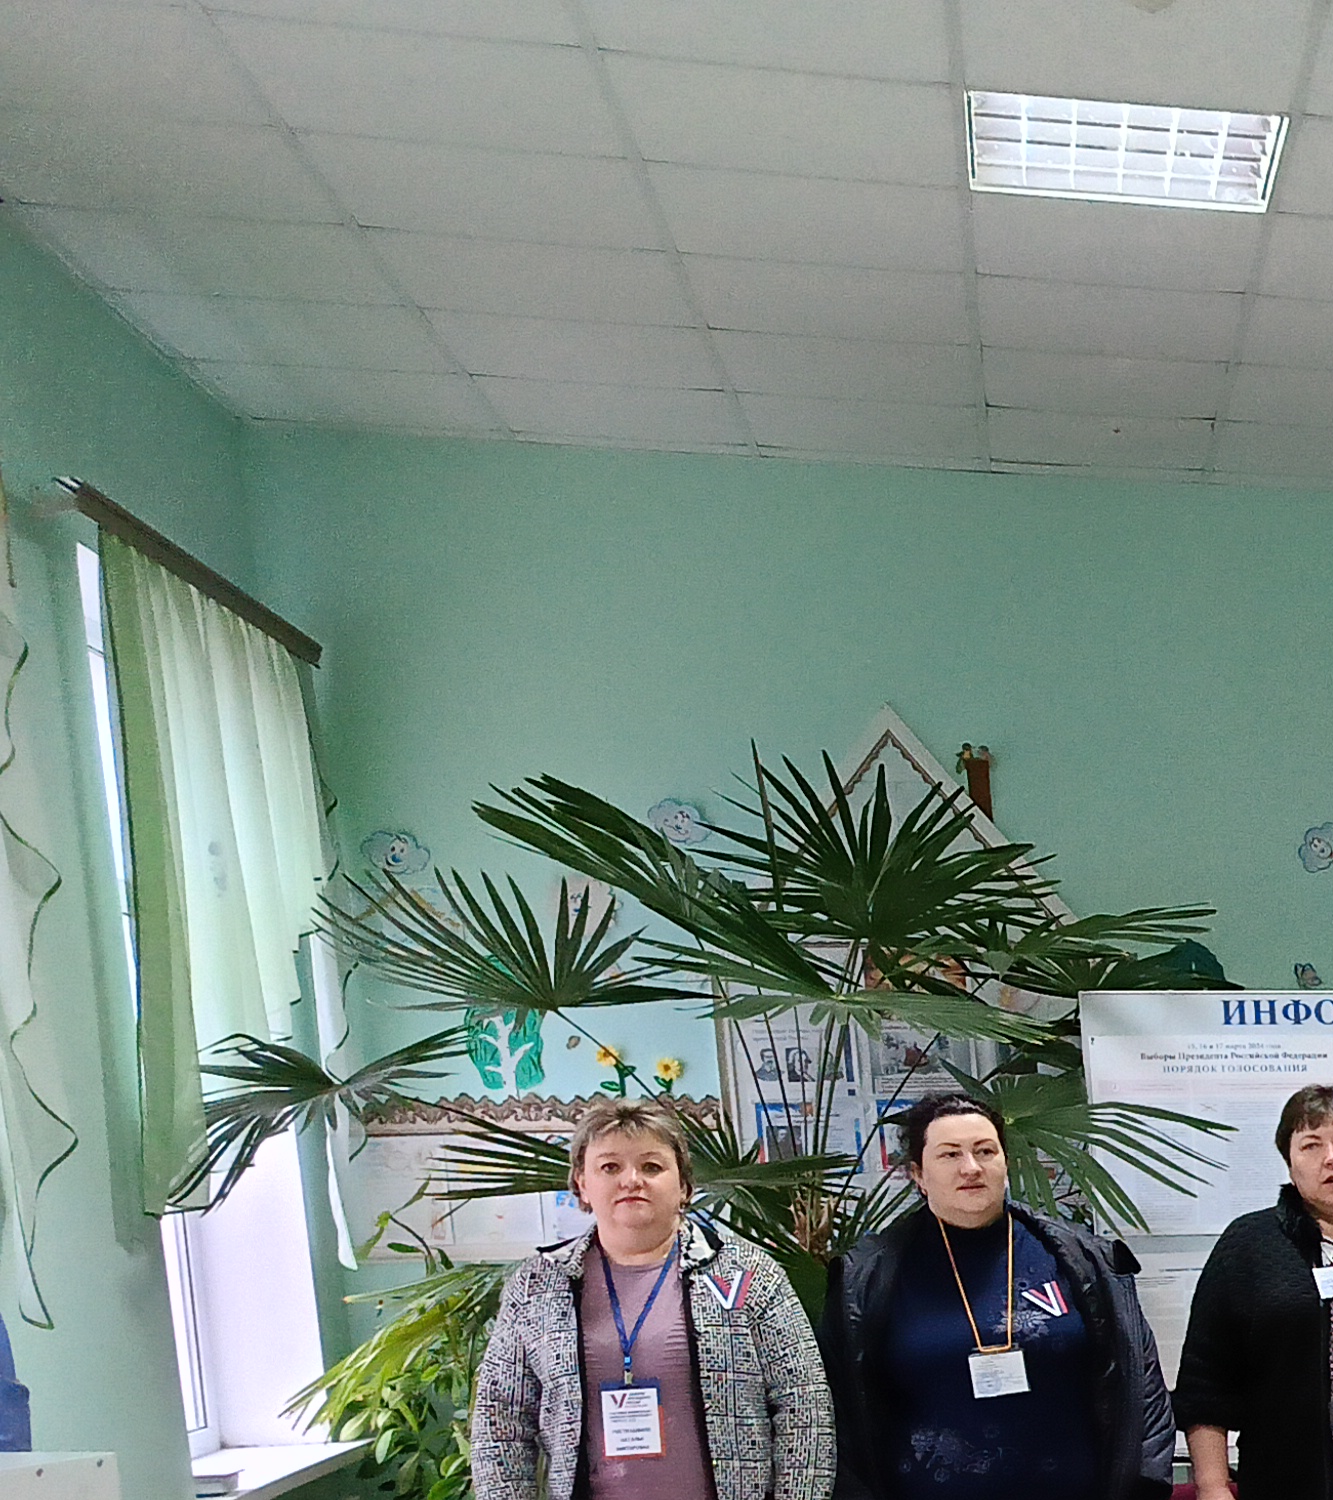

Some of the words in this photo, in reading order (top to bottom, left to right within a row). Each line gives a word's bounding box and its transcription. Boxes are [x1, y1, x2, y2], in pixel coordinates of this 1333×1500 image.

[1140, 1052, 1177, 1061] Выборы
[1178, 1051, 1229, 1061] Президента
[1230, 1051, 1280, 1061] Российской
[1281, 1050, 1328, 1061] Федерации
[1163, 1064, 1218, 1074] ПОРЯДОК
[1220, 1063, 1308, 1074] ГОЛОСОВАНИЯ
